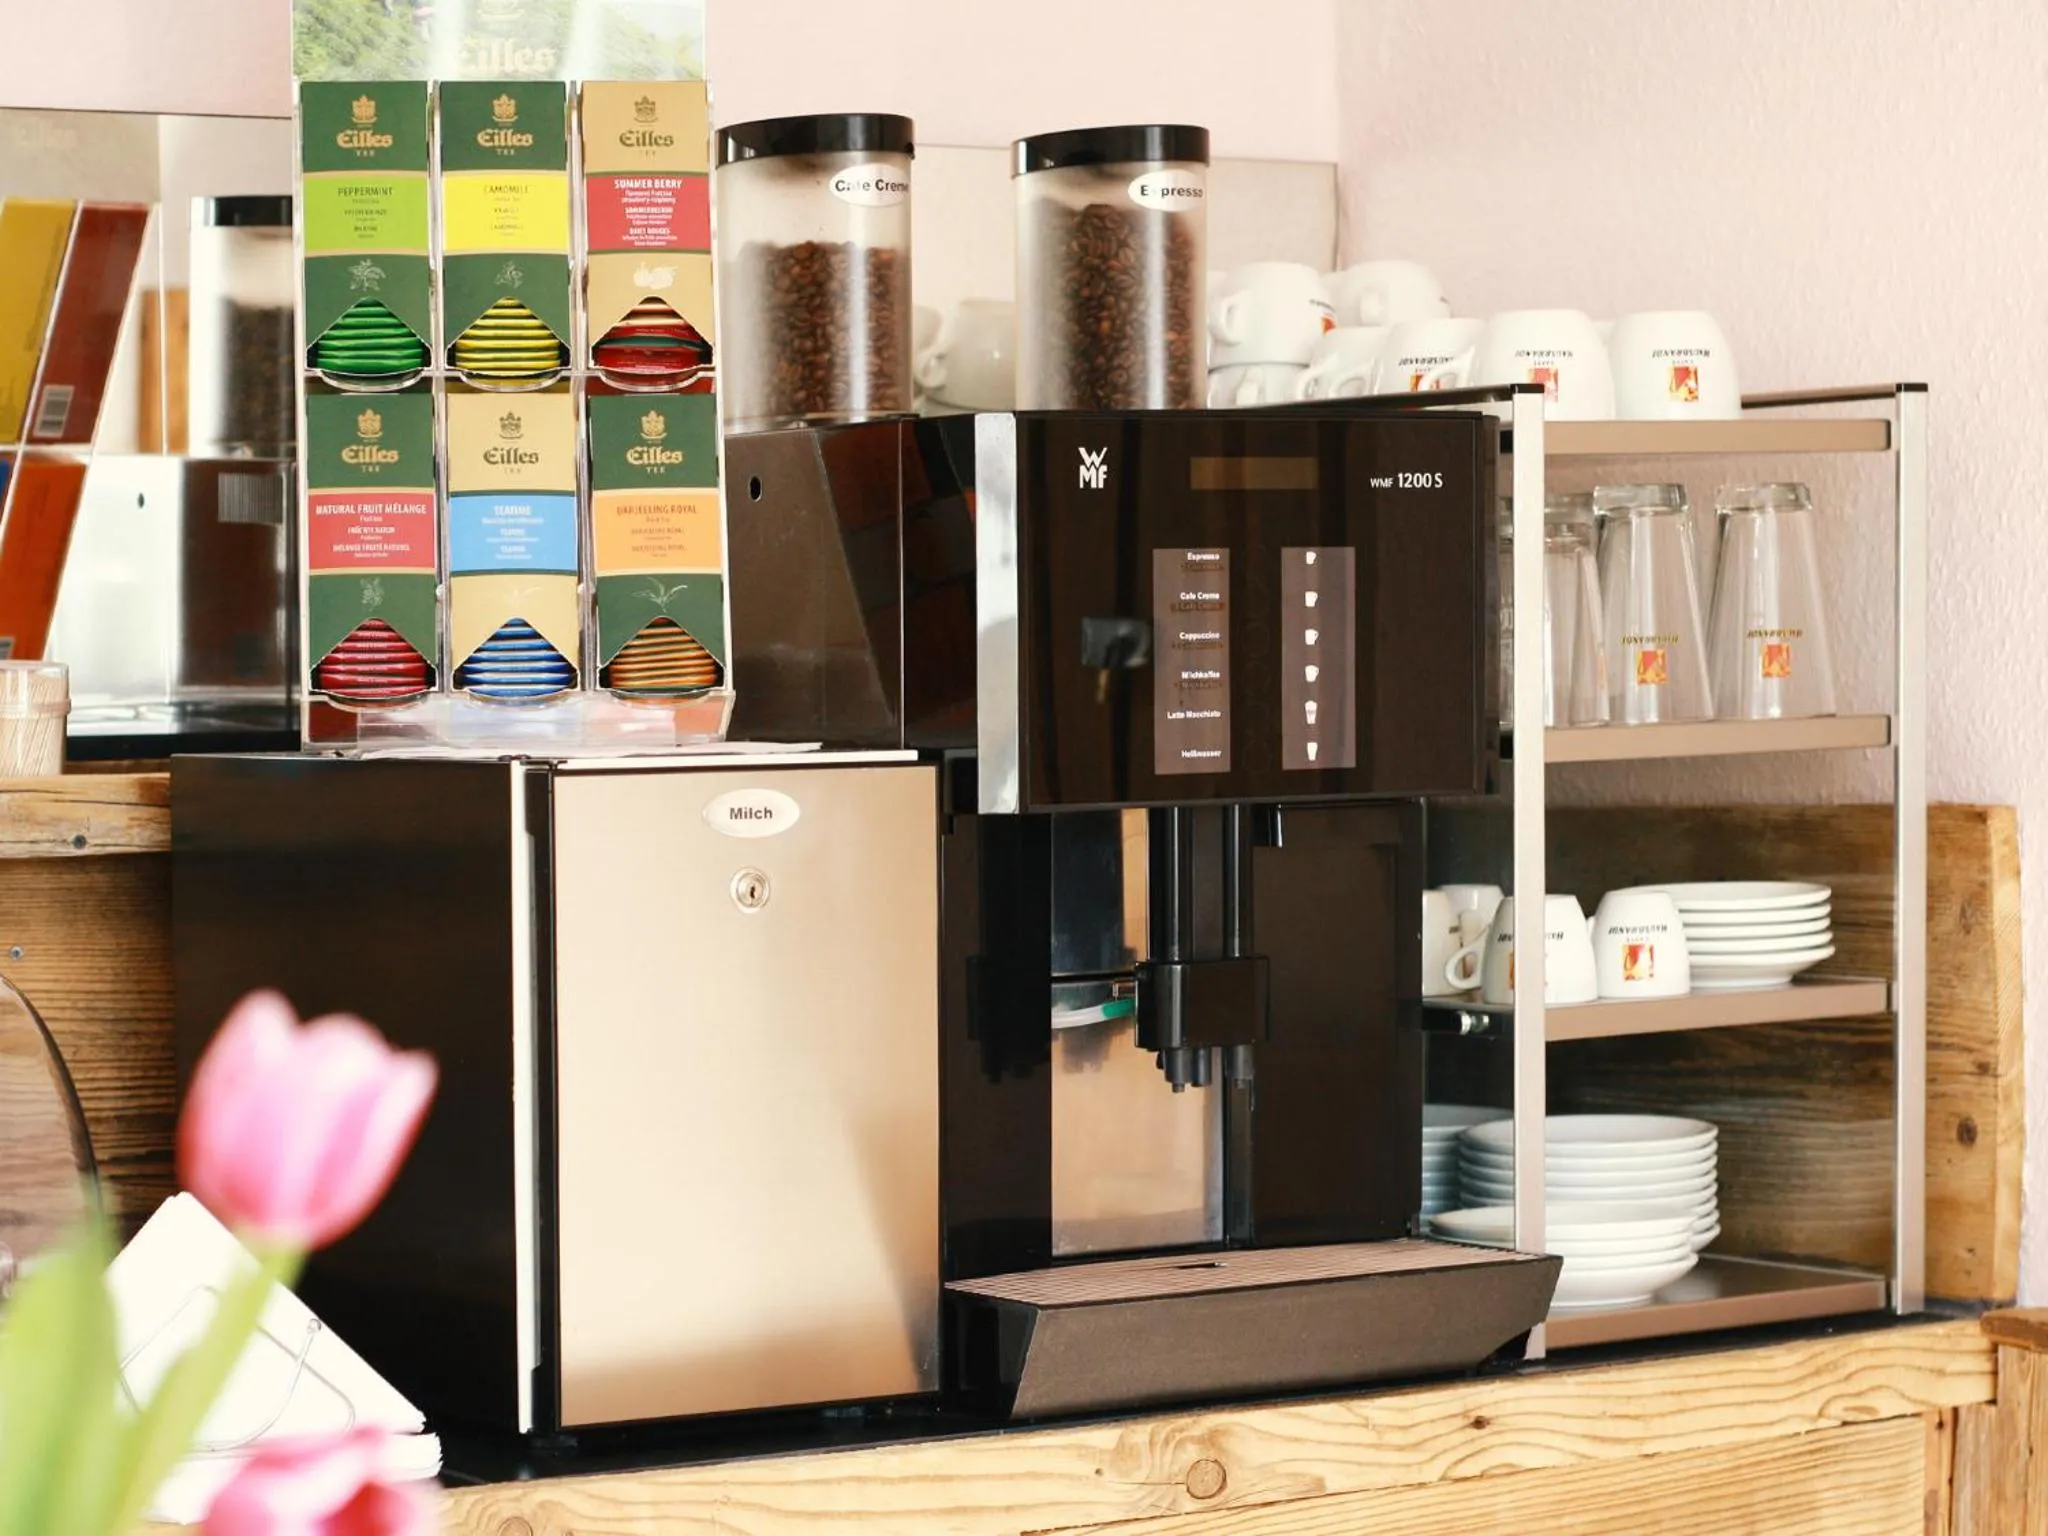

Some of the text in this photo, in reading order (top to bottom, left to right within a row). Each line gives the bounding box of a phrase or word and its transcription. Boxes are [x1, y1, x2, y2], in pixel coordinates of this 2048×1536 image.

[336, 129, 394, 148] Eilles
[476, 128, 534, 147] Eilles
[619, 130, 675, 148] Eilles
[337, 186, 393, 197] PEPPERMINT
[614, 178, 682, 189] SUMMER BERRY
[341, 445, 399, 464] Eilles
[483, 447, 540, 466] Eilles
[626, 446, 684, 465] Eilles
[1370, 471, 1443, 489] WMF 1200 S
[315, 504, 356, 516] NATURAL
[357, 503, 384, 514] FRUIT
[670, 503, 697, 515] ROYAL
[729, 805, 774, 820] Milch
